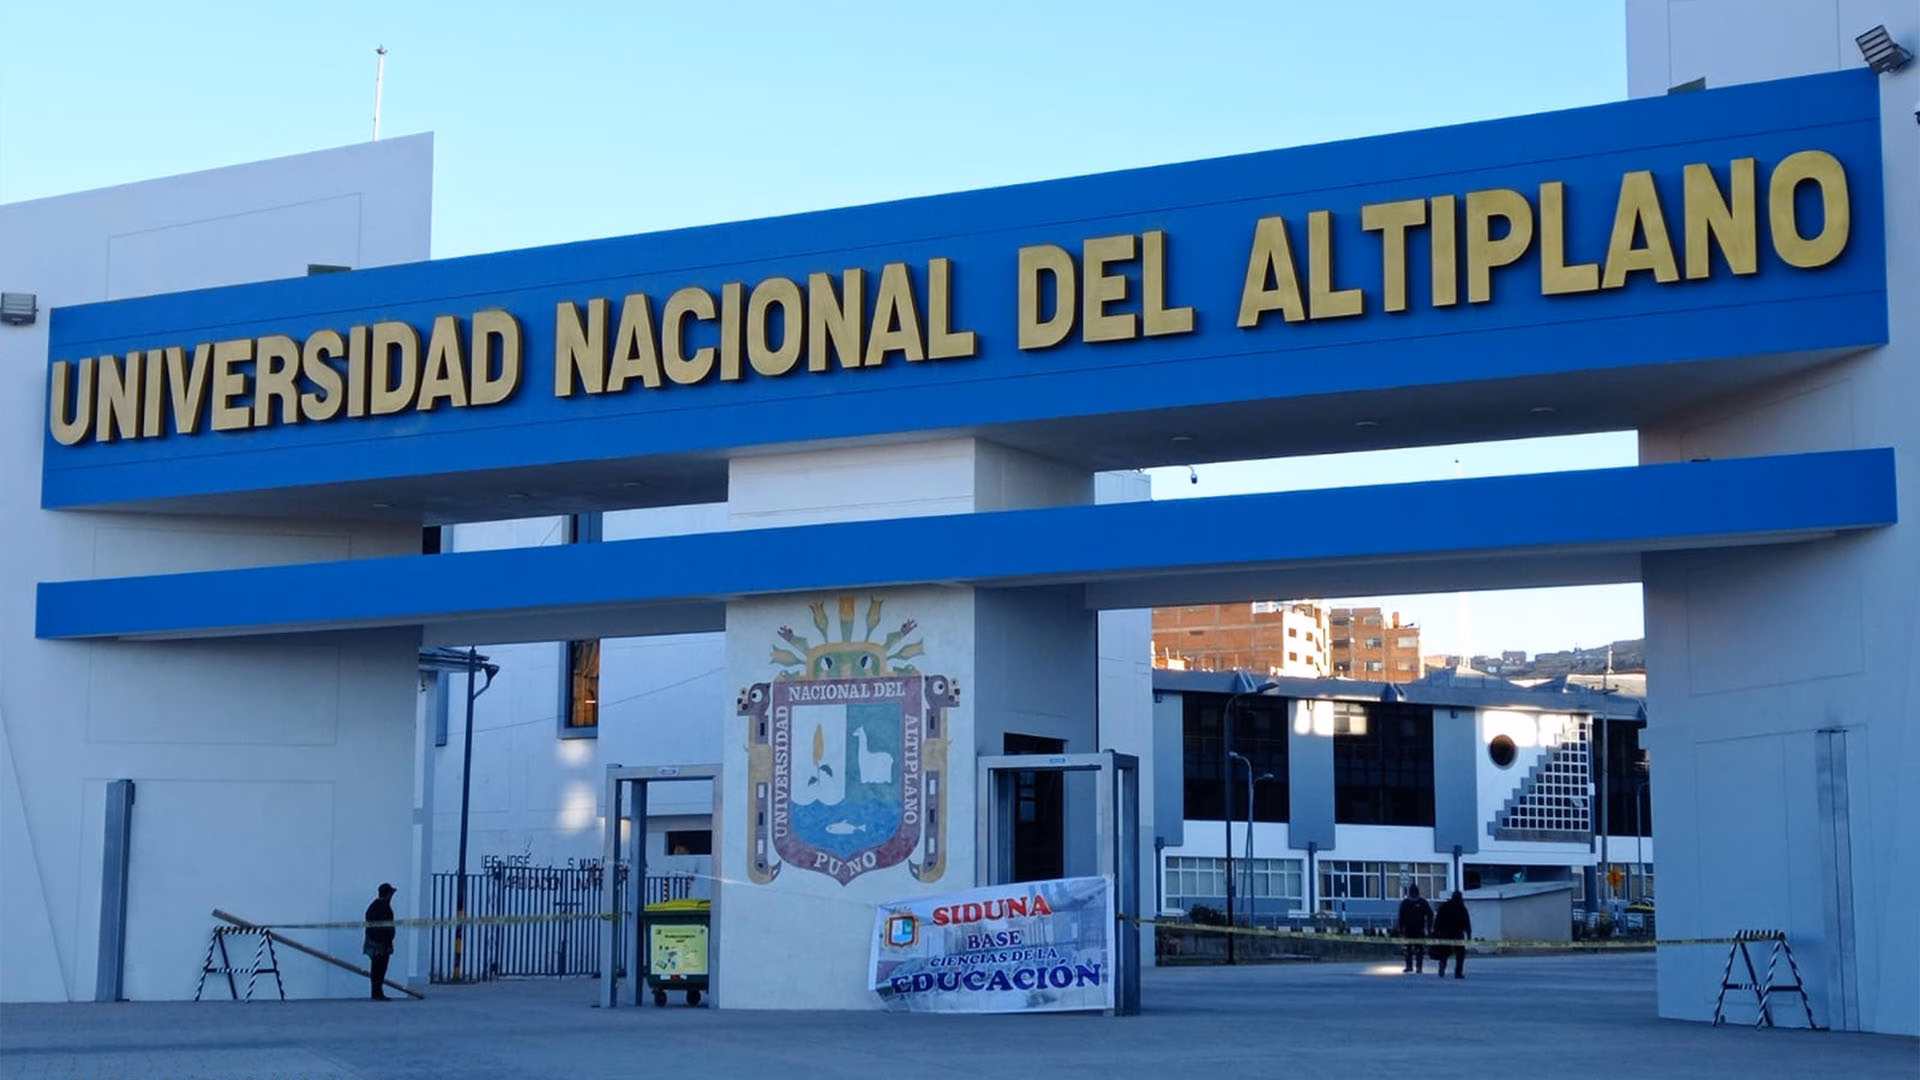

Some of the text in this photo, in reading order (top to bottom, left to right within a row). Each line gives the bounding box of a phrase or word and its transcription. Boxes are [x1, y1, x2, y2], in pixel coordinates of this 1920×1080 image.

[50, 149, 1851, 447] UNIVERSIDAD NACIONAL DEL ALTIPLANO
[788, 681, 906, 701] NACIONAL DEL
[775, 705, 788, 838] UNIVERSIDAD
[903, 714, 918, 825] ALTIPLANO
[932, 895, 1052, 926] SIDUNA
[968, 930, 1022, 949] BASE
[930, 948, 1057, 967] CIENCIAS DE LA
[891, 959, 1102, 993] EDUCACIÓN
